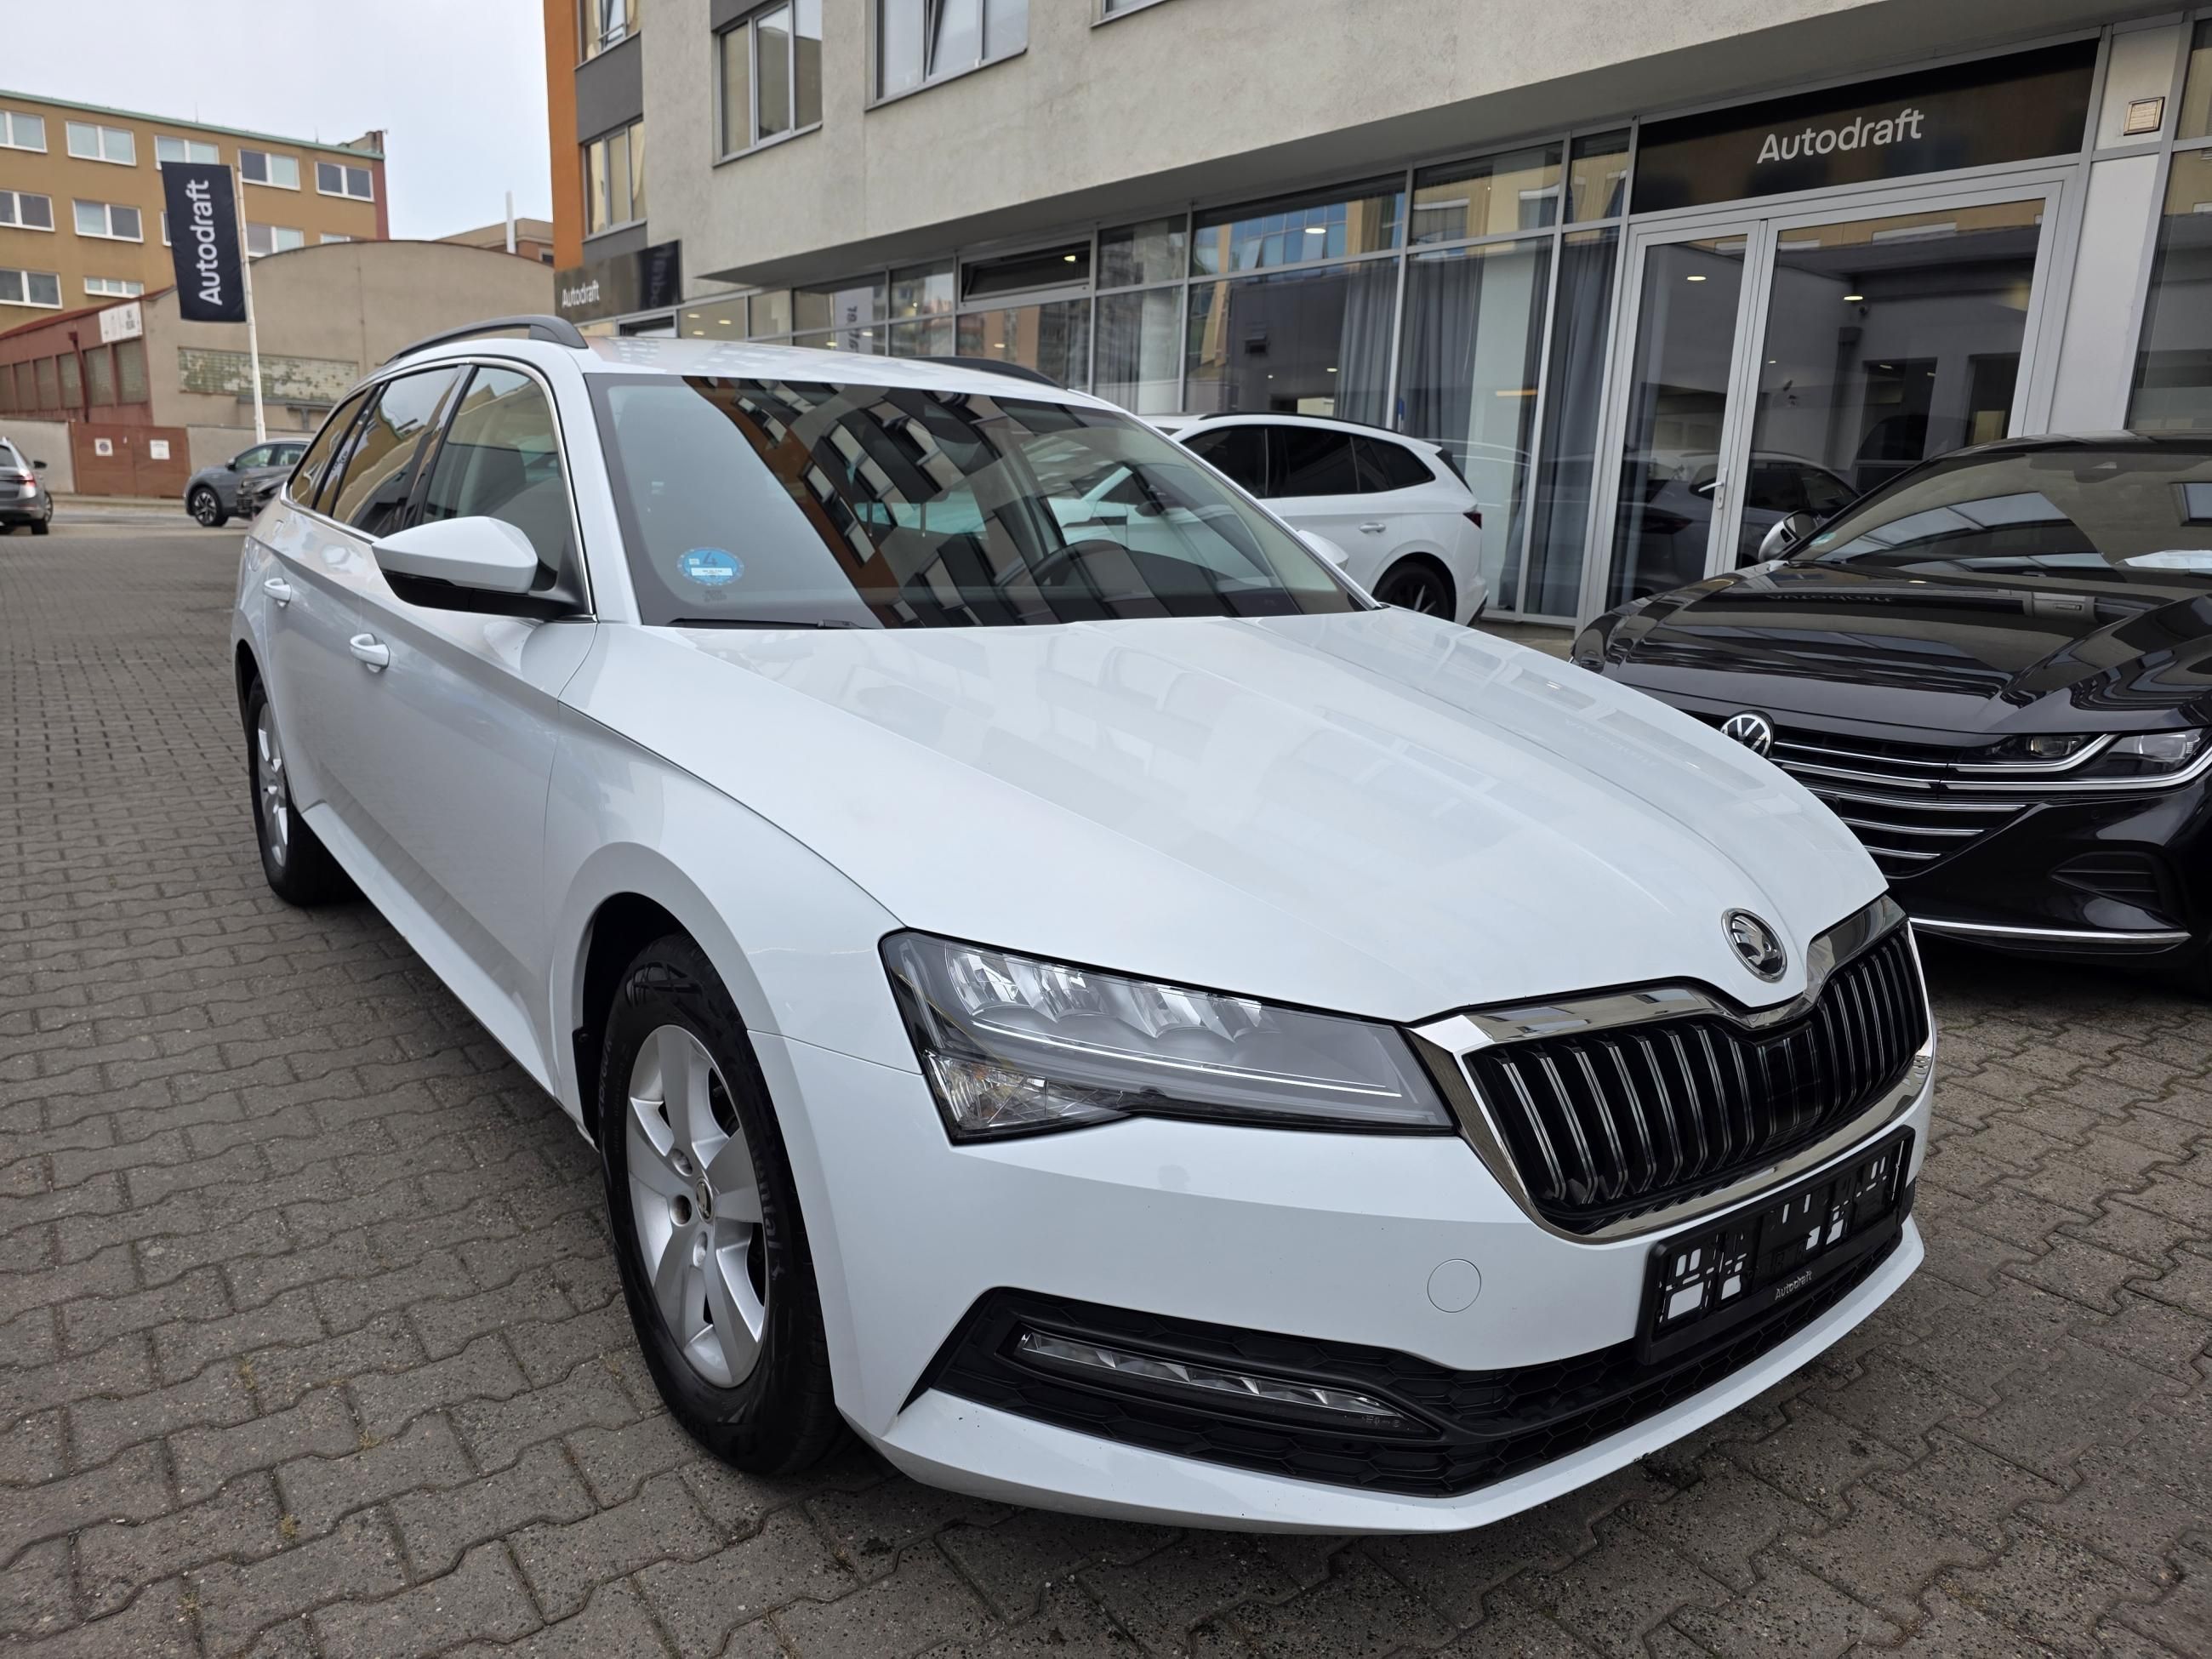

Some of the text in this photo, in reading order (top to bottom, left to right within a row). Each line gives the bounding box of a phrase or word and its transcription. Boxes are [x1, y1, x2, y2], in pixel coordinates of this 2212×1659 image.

[1756, 108, 1924, 164] Autodraft
[185, 179, 223, 306] Autodraft
[562, 279, 600, 308] Autodraft
[1775, 1269, 1813, 1301] Autodraft
